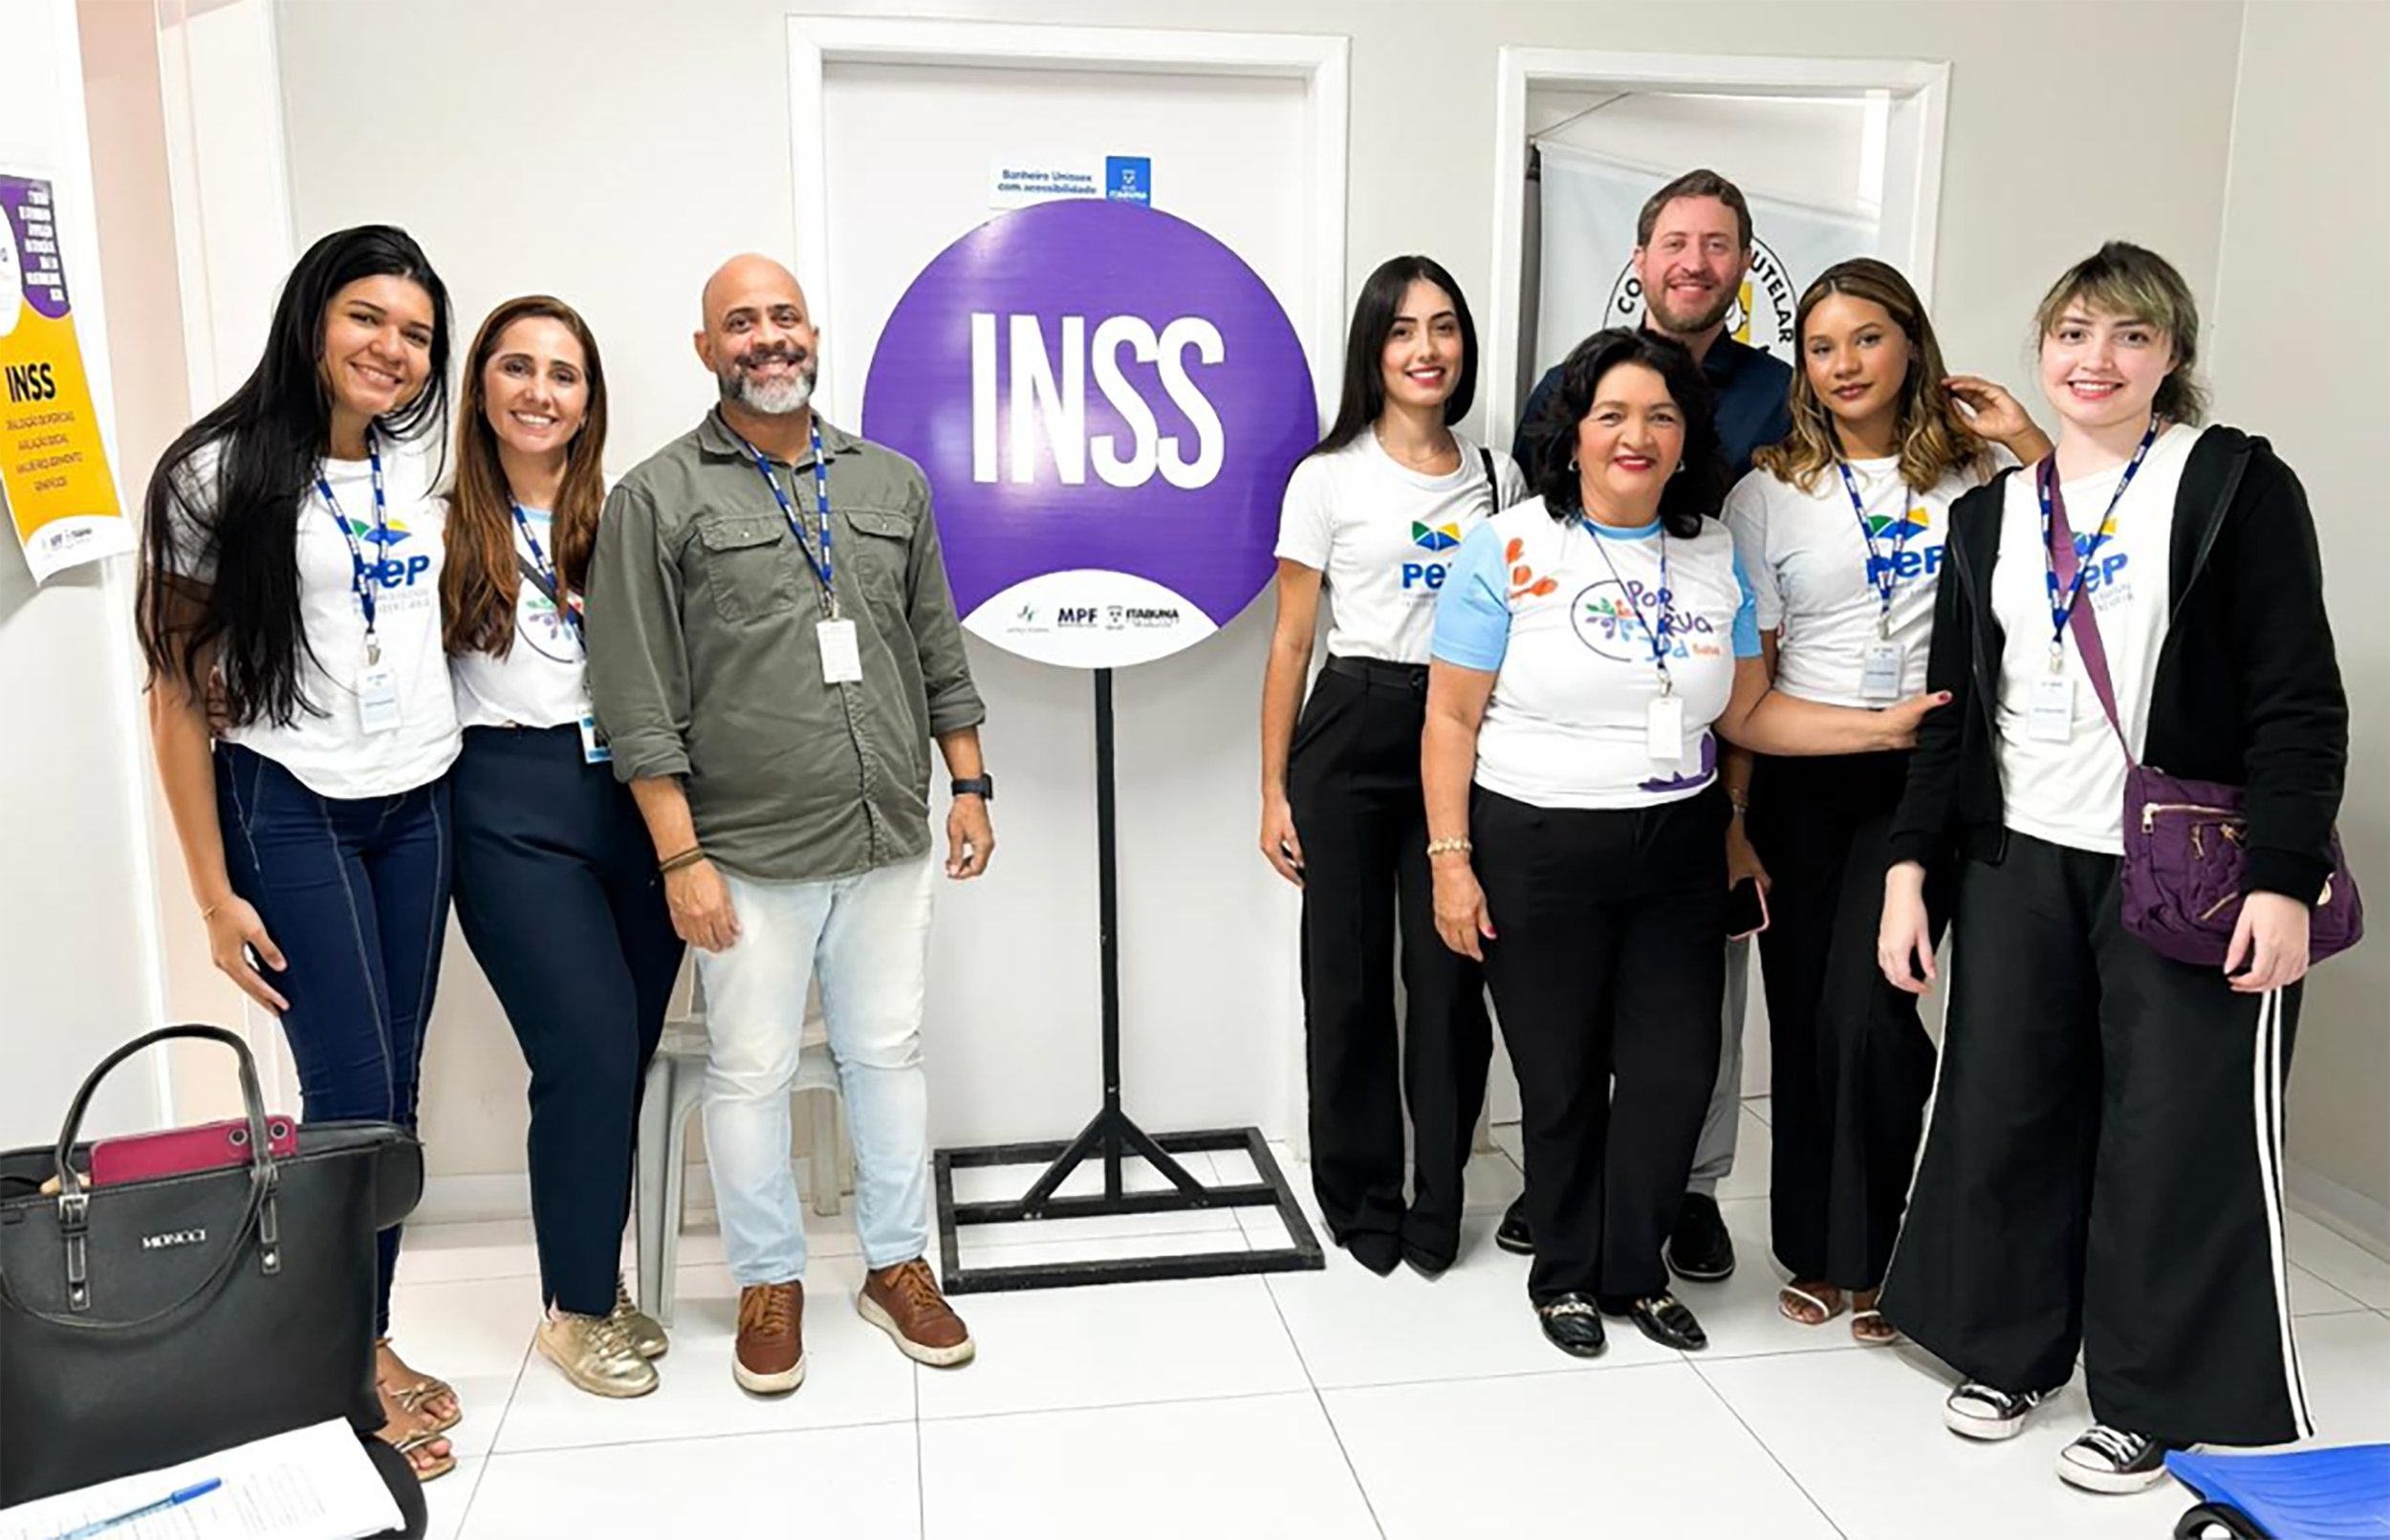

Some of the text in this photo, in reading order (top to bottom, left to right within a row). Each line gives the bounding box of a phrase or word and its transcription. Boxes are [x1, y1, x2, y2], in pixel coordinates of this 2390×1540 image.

[1002, 169, 1050, 181] Banheiro
[997, 183, 1097, 194] com acessibilidade
[1749, 250, 1795, 344] UTELAR
[6, 362, 56, 403] INSS
[971, 313, 1225, 489] INSS
[1057, 608, 1098, 622] MPF
[1126, 609, 1180, 619] ITABUNA
